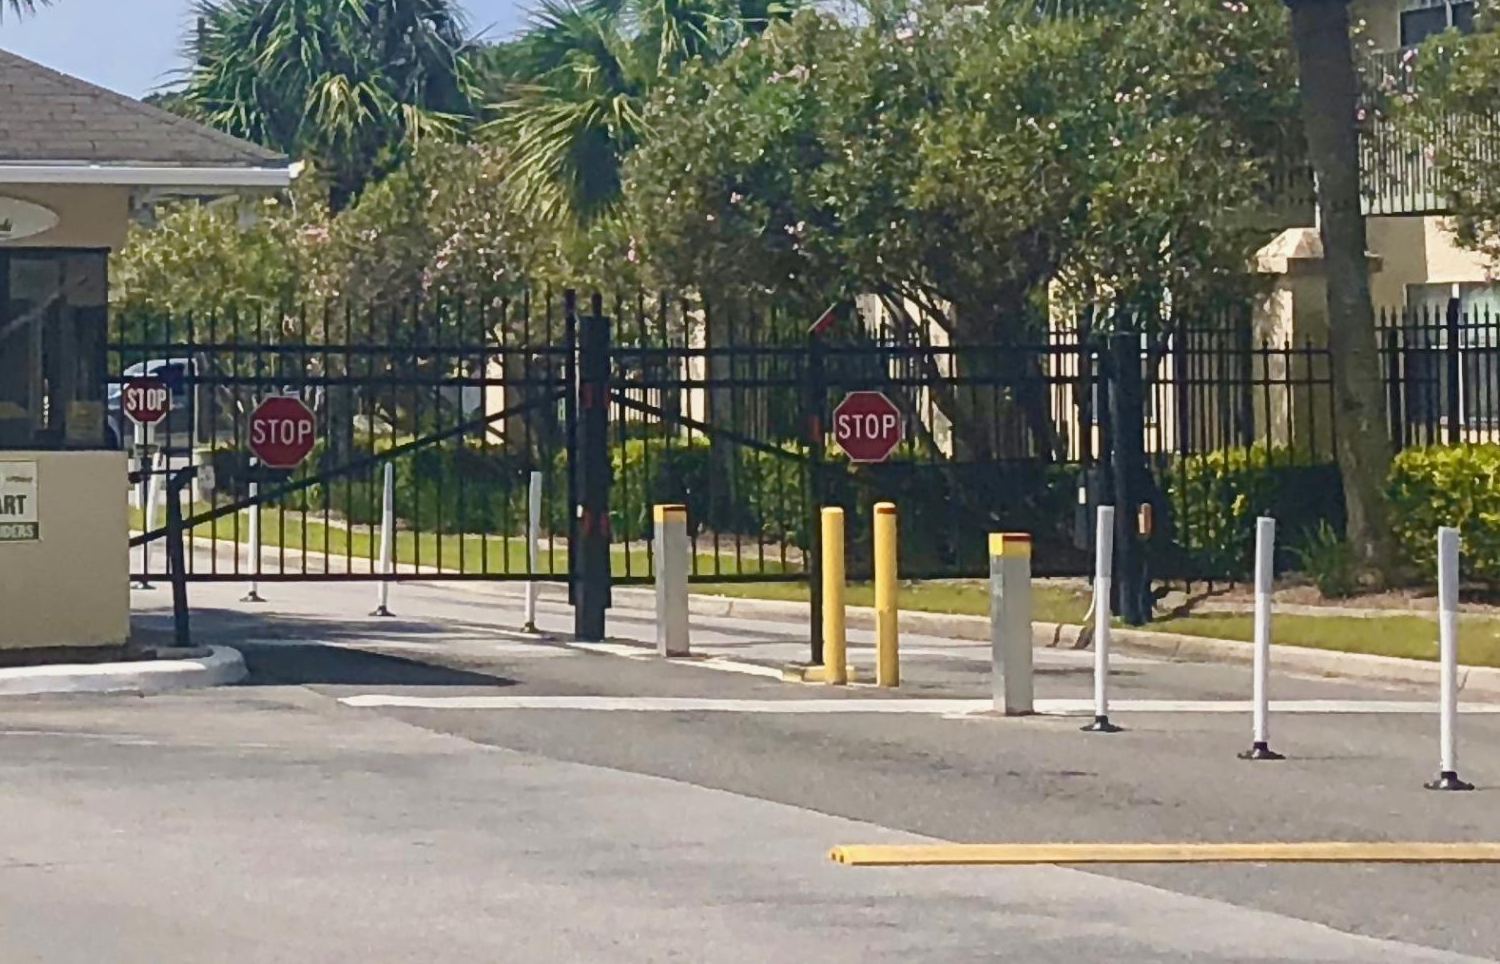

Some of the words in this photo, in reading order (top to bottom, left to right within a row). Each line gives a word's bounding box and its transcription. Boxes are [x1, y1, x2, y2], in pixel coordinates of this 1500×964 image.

[127, 387, 167, 411] STOP
[252, 419, 313, 445] STOP
[838, 413, 896, 440] STOP
